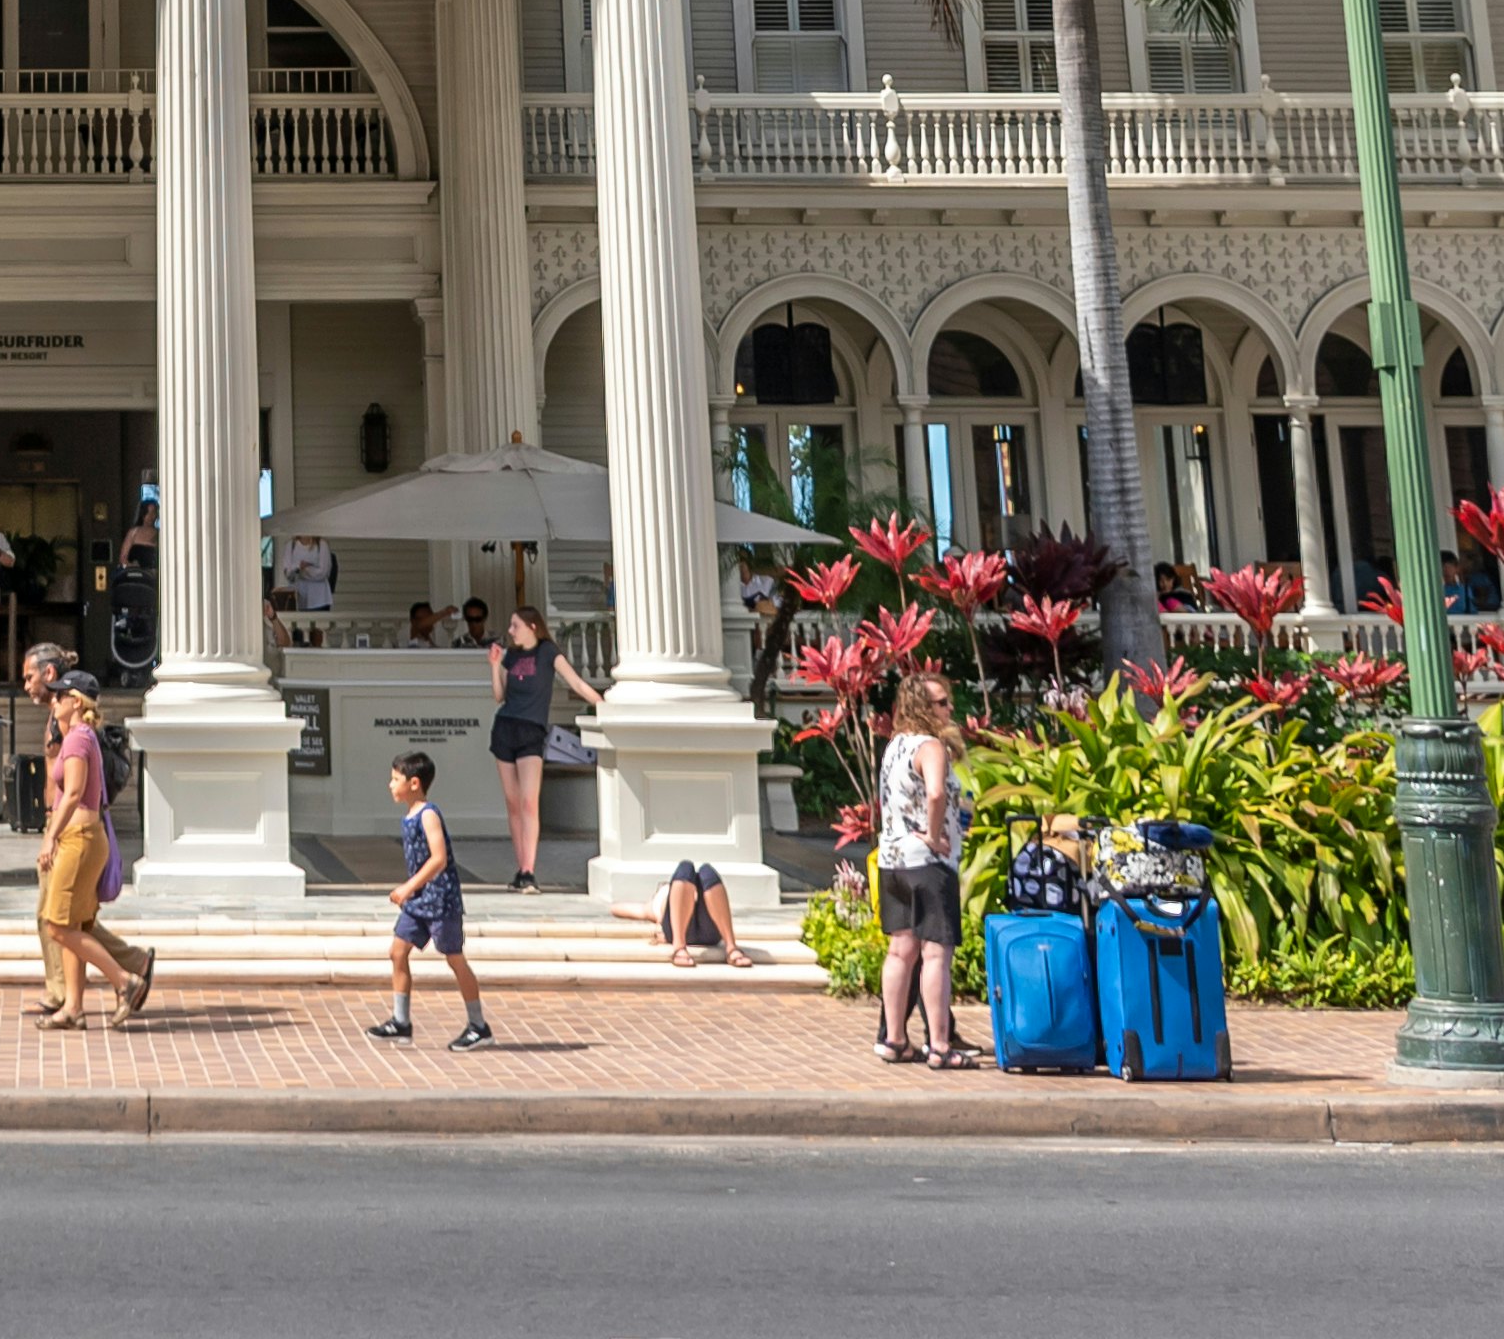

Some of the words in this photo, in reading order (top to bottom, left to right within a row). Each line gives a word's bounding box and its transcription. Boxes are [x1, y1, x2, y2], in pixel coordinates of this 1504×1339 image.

[10, 352, 48, 360] RESORT
[294, 694, 316, 704] VALET
[290, 704, 320, 714] PARKING
[373, 717, 418, 728] MOANA
[420, 717, 481, 728] SURFRIDER
